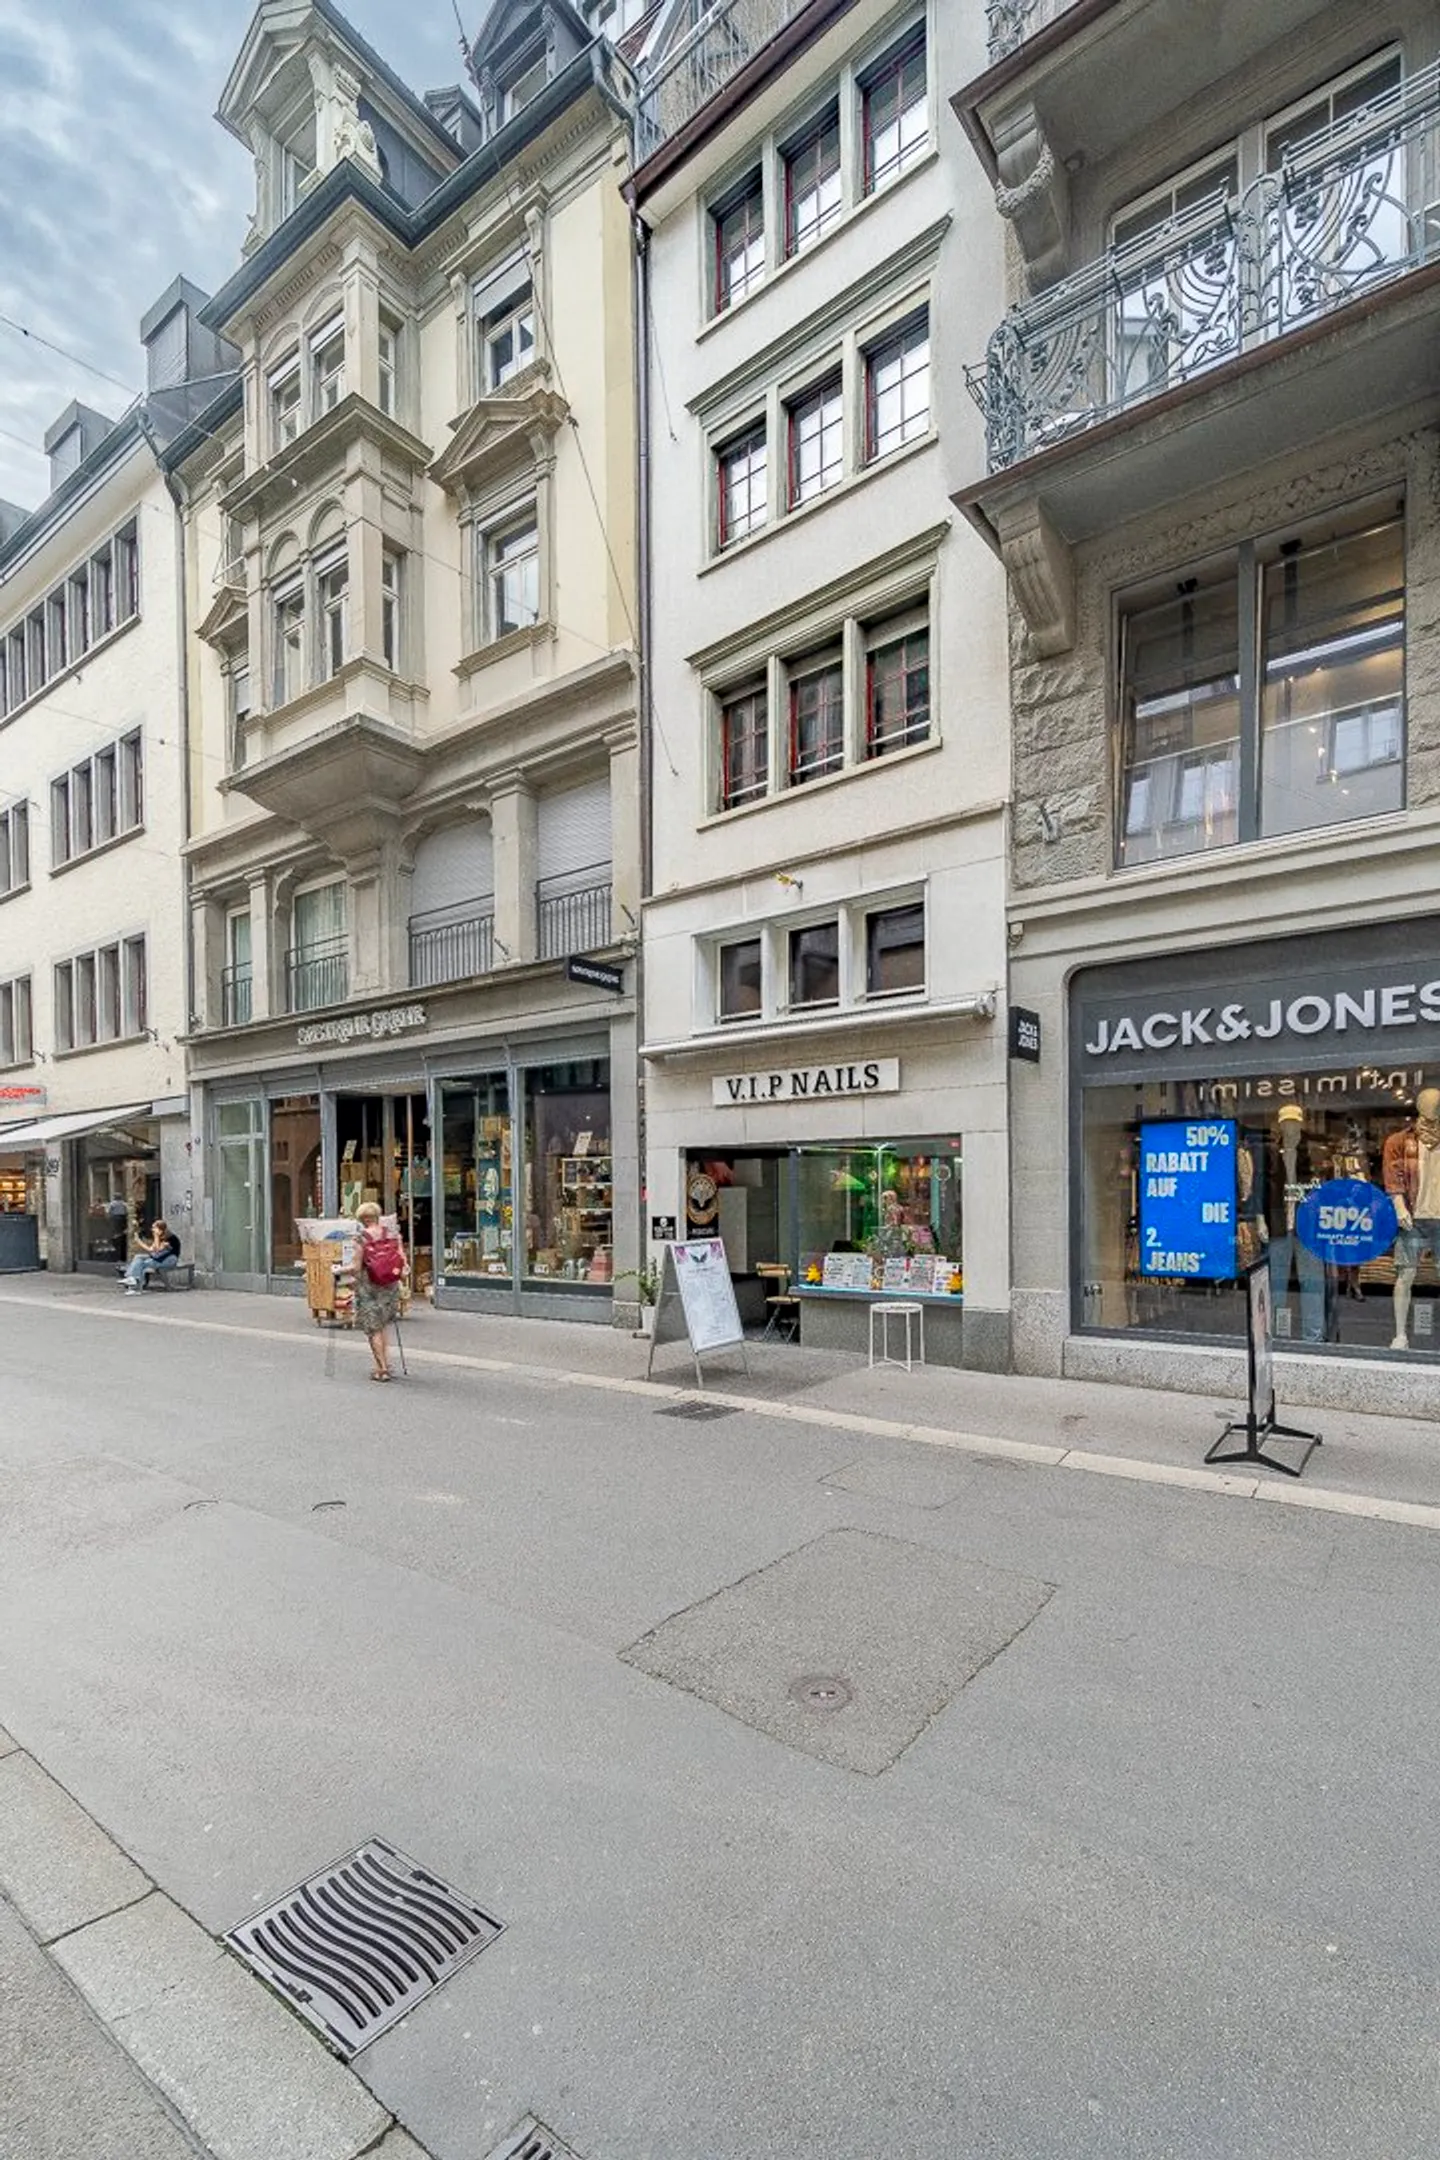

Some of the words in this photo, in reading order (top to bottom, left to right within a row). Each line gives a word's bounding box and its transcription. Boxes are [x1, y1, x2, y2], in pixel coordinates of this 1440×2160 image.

[727, 1074, 783, 1100] V.I.P
[791, 1064, 880, 1096] NAILS
[1186, 1125, 1229, 1147] 50%
[1146, 1151, 1209, 1173] RABATT
[1147, 1178, 1178, 1198] AUF
[1202, 1202, 1230, 1224] DIE
[1319, 1206, 1374, 1232] 50%
[1146, 1227, 1162, 1247] 2.
